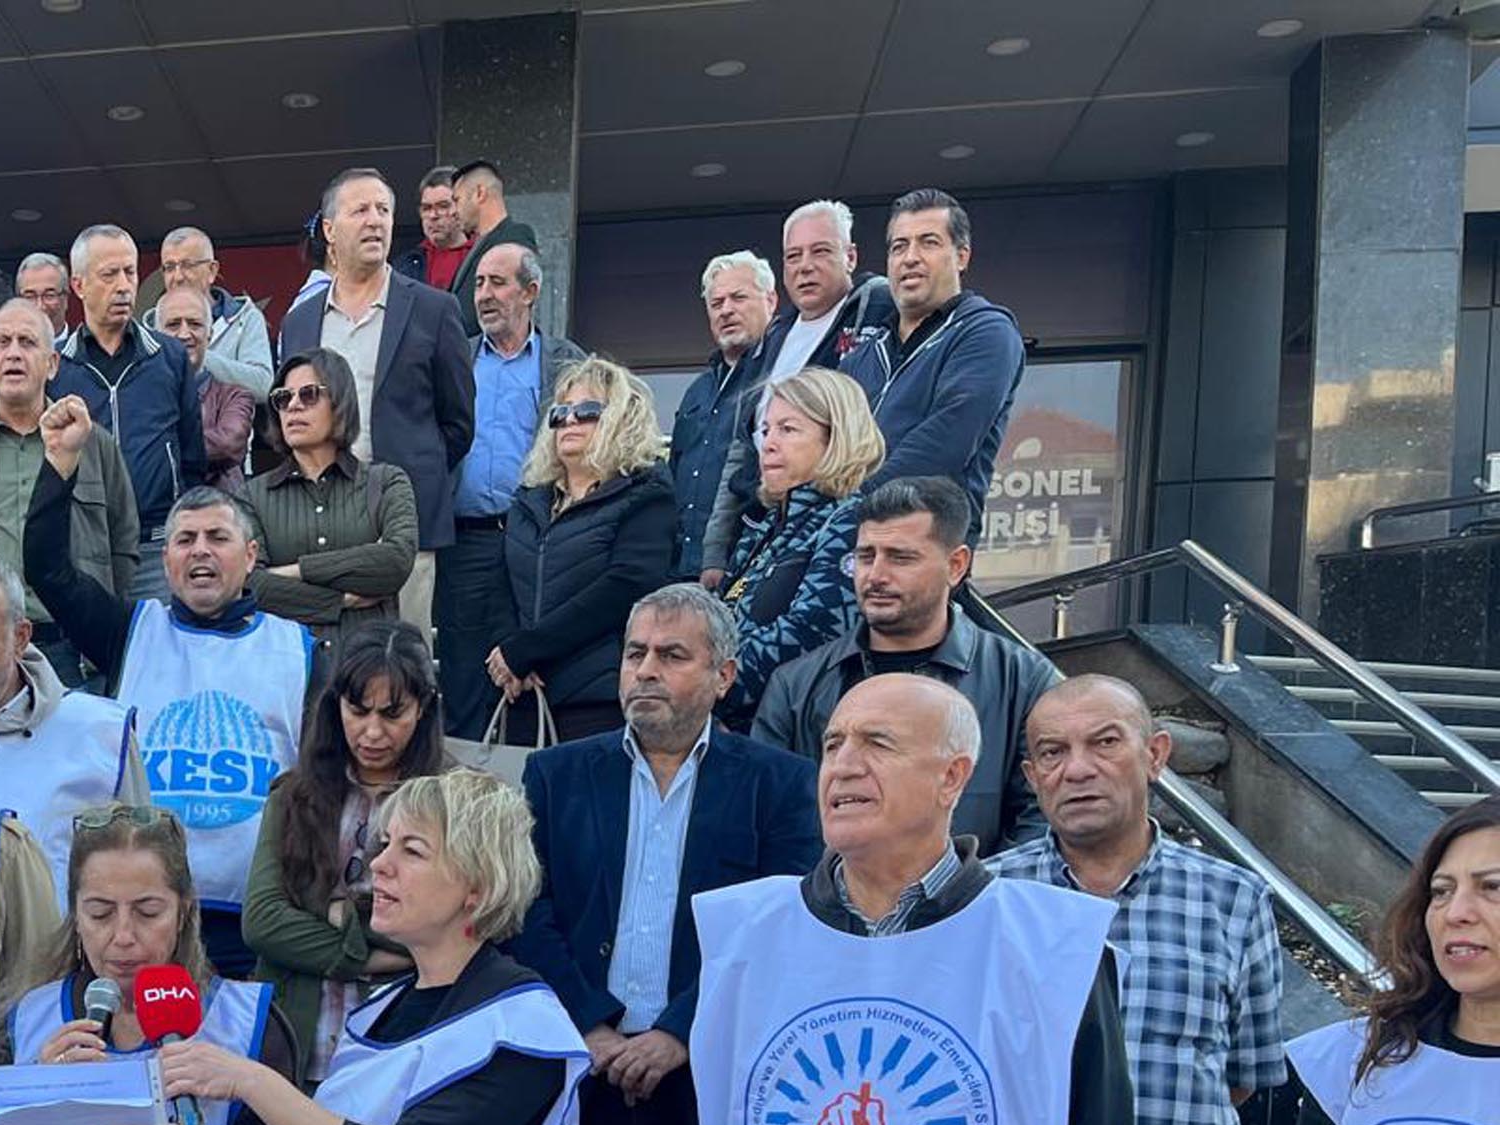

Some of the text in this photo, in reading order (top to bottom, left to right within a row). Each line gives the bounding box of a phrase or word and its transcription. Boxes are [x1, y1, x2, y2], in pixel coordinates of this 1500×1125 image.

[185, 802, 232, 822] 1995
[143, 984, 196, 1002] DHA
[768, 1031, 799, 1063] Yerel
[799, 1009, 862, 1034] Yönetim
[866, 1007, 940, 1042] Hizmetleri
[938, 1038, 984, 1110] Emekçileri
